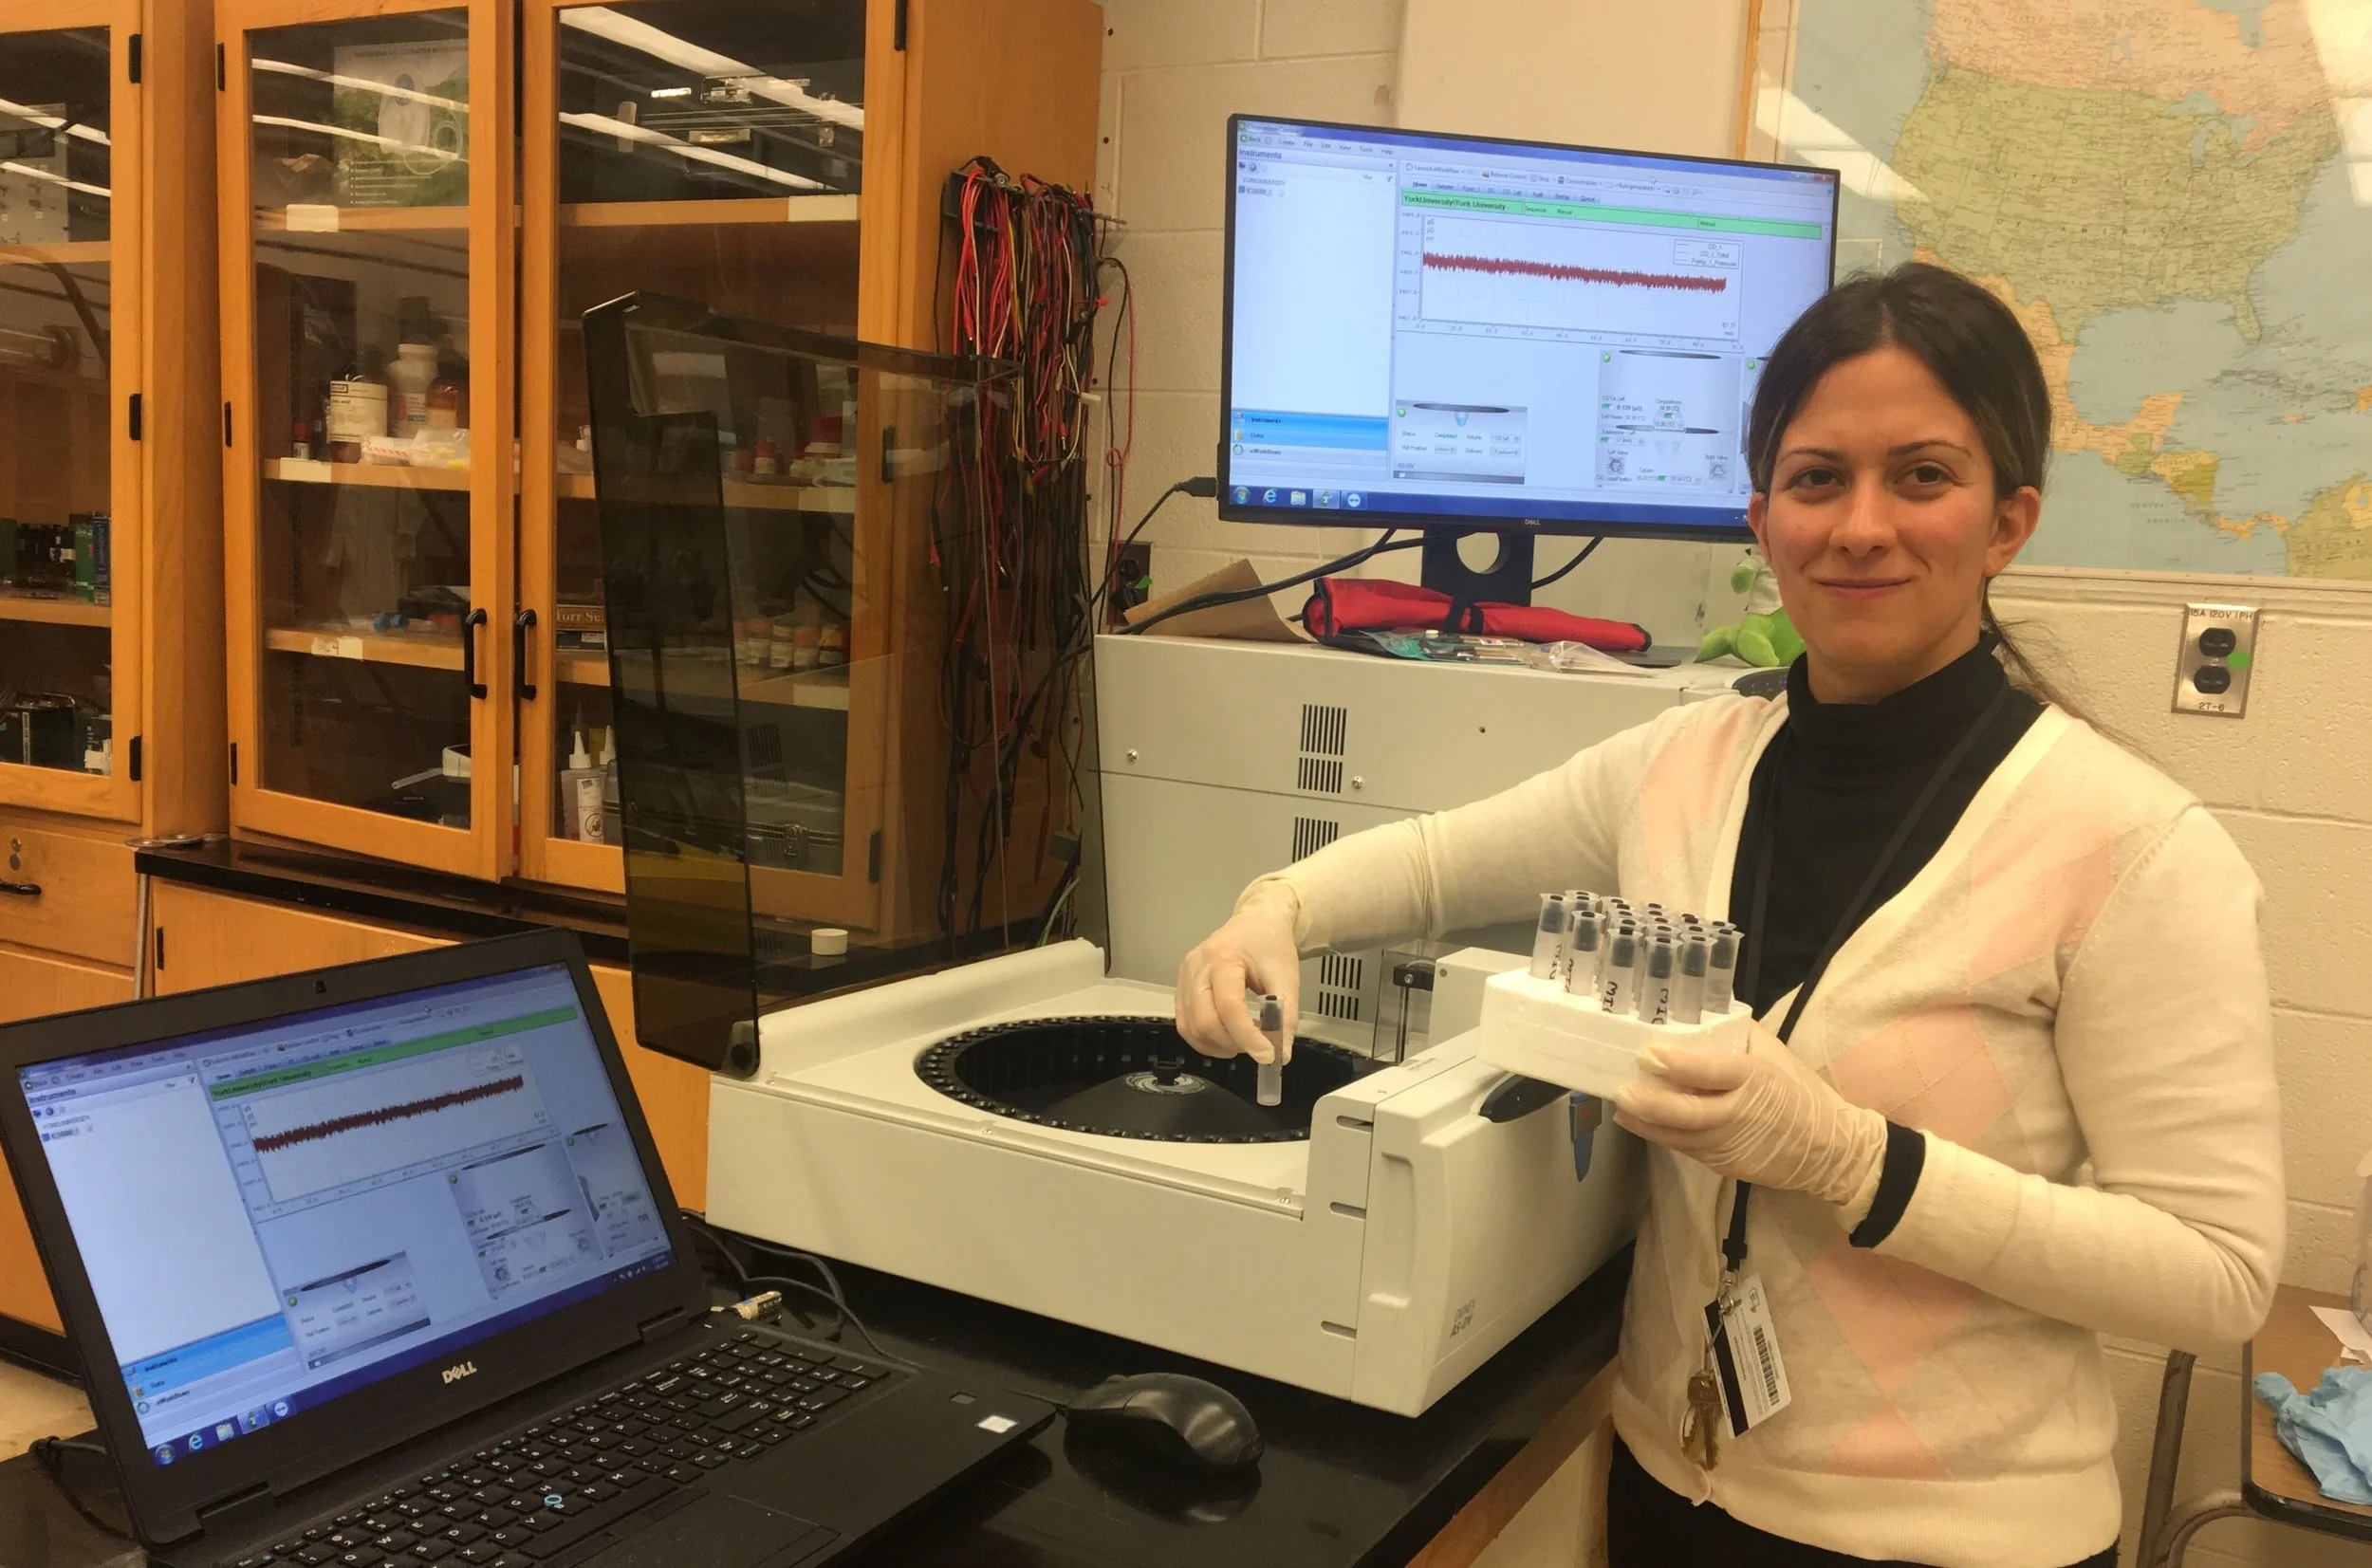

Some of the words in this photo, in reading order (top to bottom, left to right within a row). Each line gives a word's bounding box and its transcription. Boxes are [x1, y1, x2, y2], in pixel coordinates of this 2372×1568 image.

[1238, 148, 1283, 159] Instruments
[1472, 197, 1507, 211] University
[1524, 518, 1542, 526] DELL
[2190, 607, 2206, 618] 15A
[2209, 609, 2233, 619] 120V
[28, 1088, 77, 1104] Instruments
[441, 1360, 477, 1385] DELL
